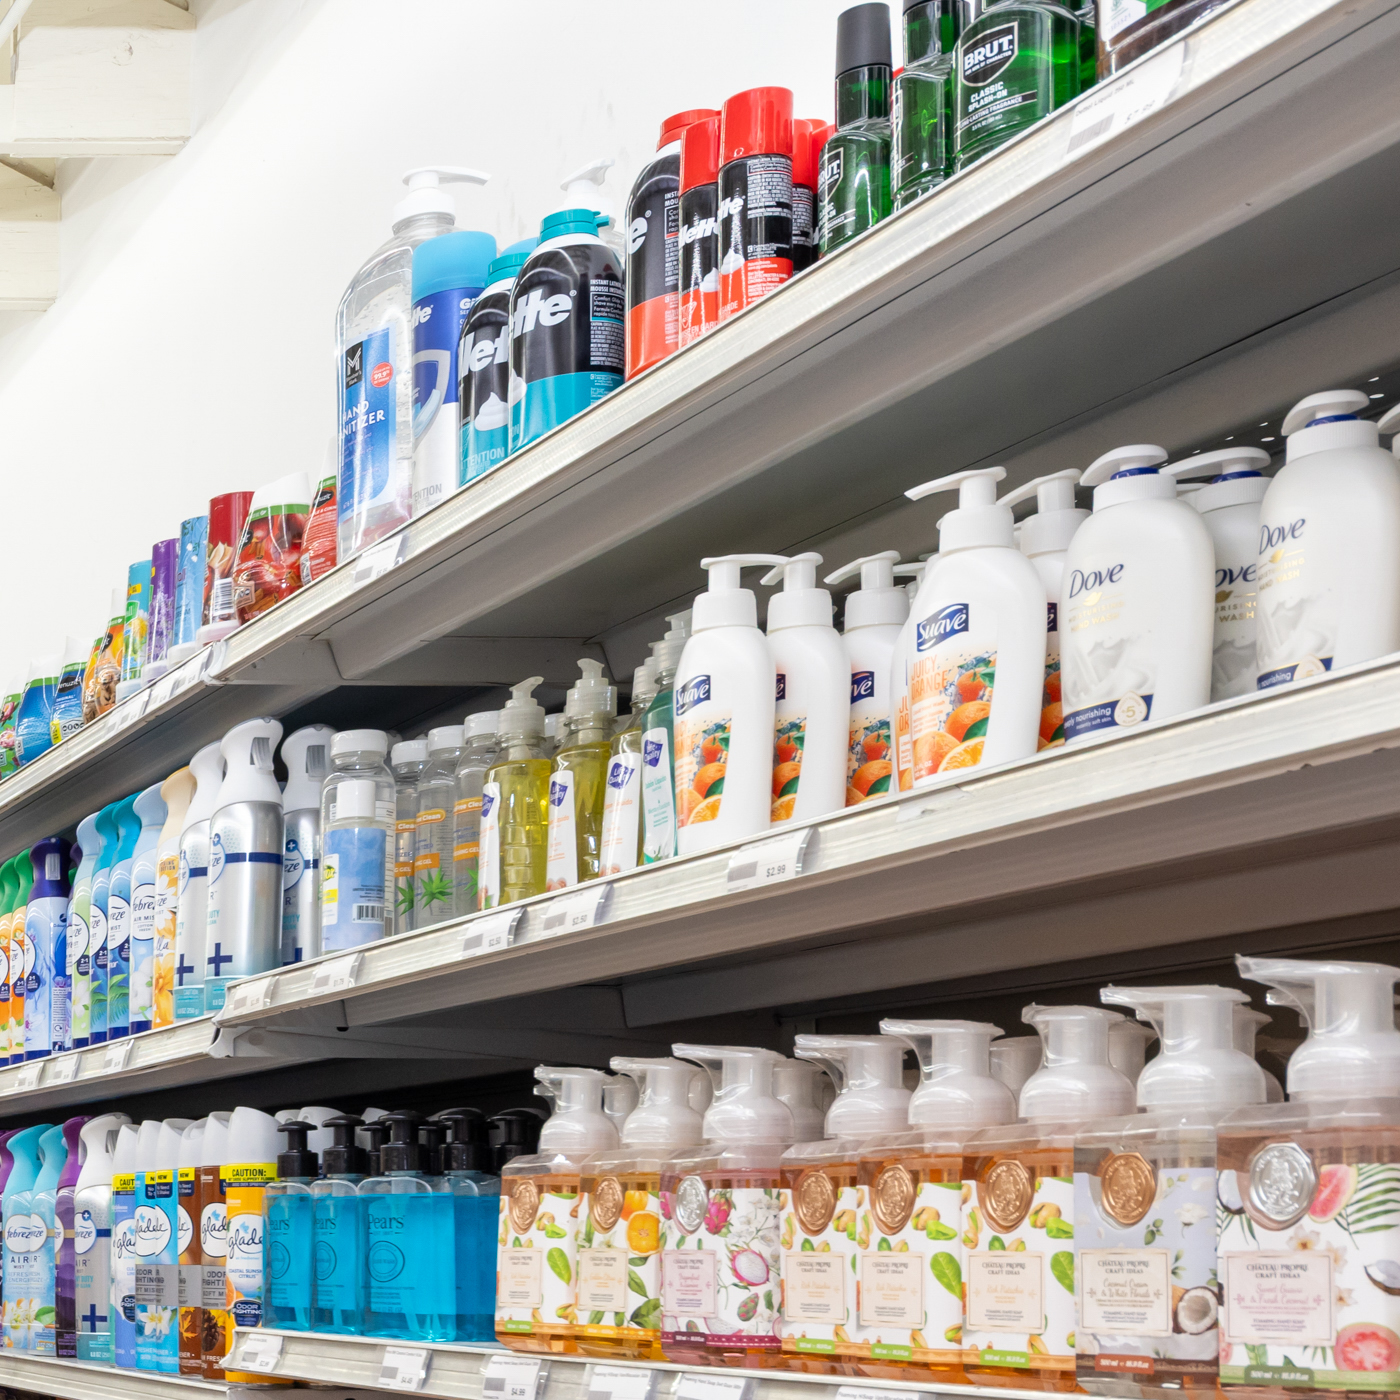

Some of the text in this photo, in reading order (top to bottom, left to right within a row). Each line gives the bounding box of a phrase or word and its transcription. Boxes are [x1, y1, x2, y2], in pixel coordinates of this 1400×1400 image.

[969, 82, 1004, 104] CLASSIC
[1258, 516, 1307, 555] Dove
[1069, 561, 1124, 598] Dove
[918, 611, 969, 649] Suave
[676, 680, 710, 710] Suave
[1074, 706, 1112, 721] nourishing
[767, 865, 785, 877] $2.99
[233, 1168, 267, 1178] CAUTION:
